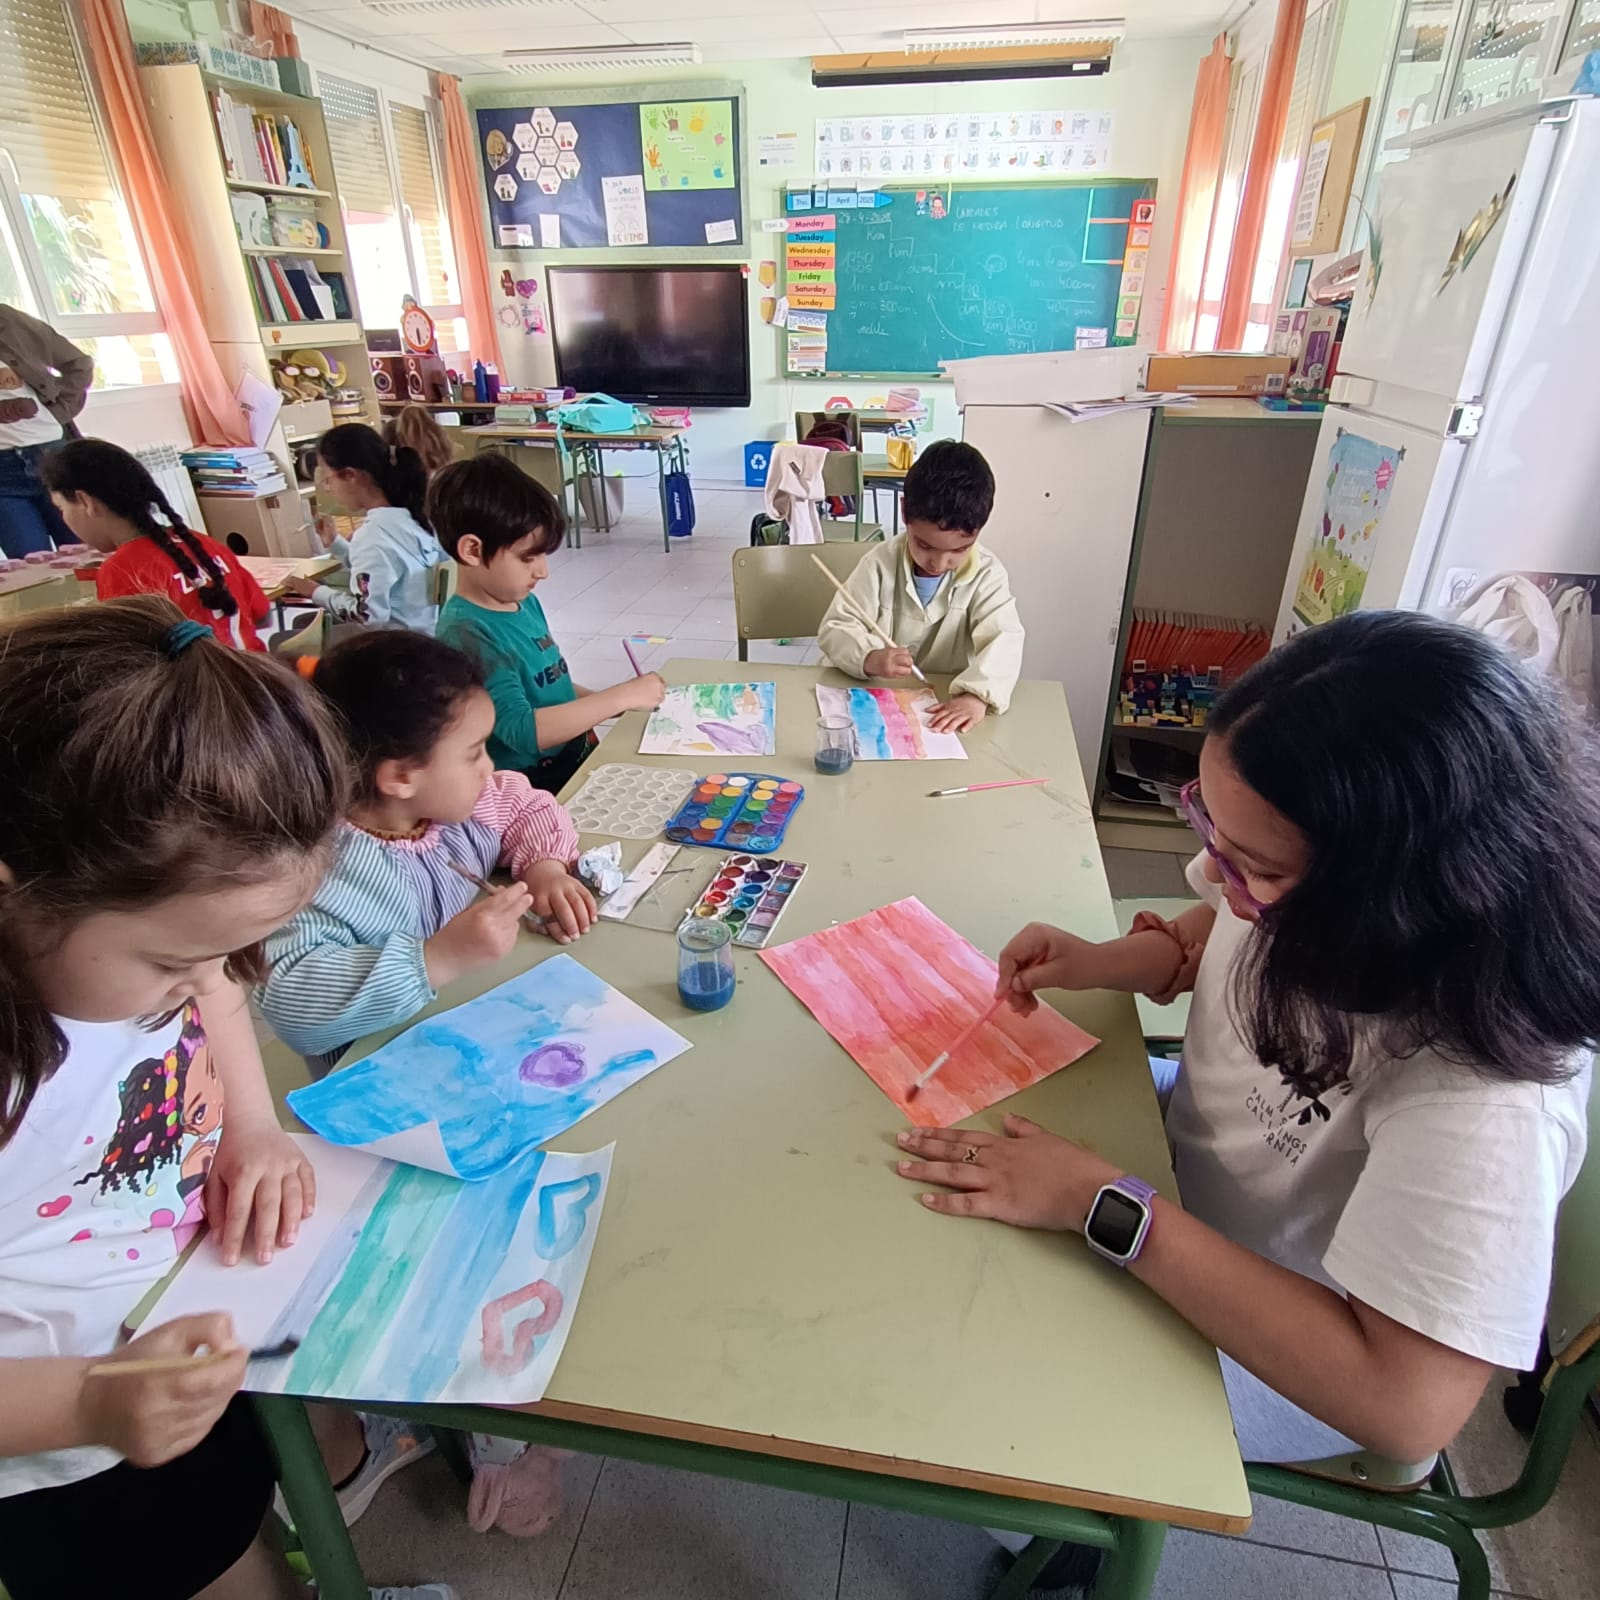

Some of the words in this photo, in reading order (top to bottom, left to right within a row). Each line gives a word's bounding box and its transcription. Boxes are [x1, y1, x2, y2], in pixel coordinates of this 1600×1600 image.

[795, 219, 824, 228] Monday
[795, 233, 824, 242] Tuesday
[789, 246, 831, 256] Wednesday
[793, 259, 826, 269] Thursday
[798, 272, 821, 281] Friday
[795, 285, 827, 294] Saturday
[797, 298, 823, 308] Sunday
